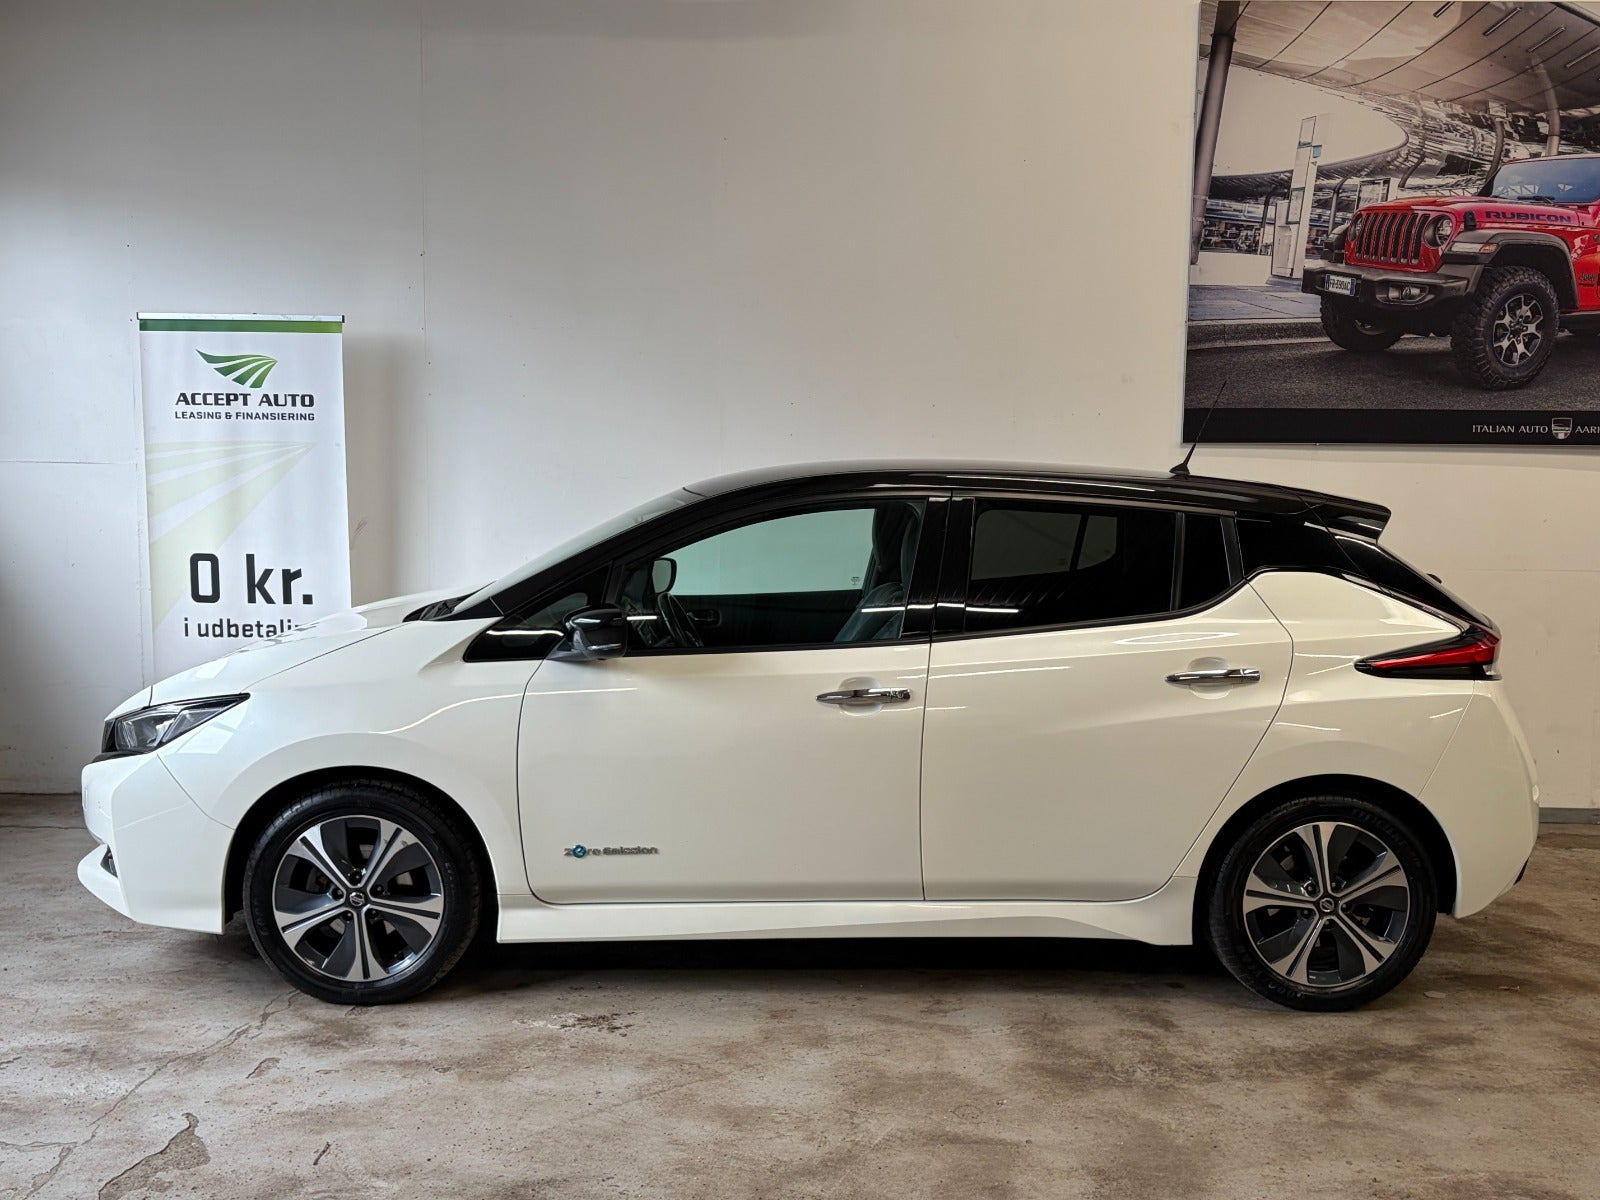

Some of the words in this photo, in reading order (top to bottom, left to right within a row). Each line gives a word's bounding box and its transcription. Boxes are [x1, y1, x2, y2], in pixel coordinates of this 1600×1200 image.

[1485, 211, 1572, 222] RUBICON
[176, 392, 251, 406] ACCEPT
[259, 394, 315, 408] AUTO
[175, 411, 222, 420] LEASING
[225, 411, 233, 420] &
[235, 412, 315, 421] FINANSIERING
[1472, 424, 1515, 433] ITALIAN
[1518, 425, 1548, 433] AUTO
[190, 553, 221, 603] 0
[245, 553, 313, 604] kr.
[184, 617, 189, 637] i
[197, 618, 300, 638] udbetali
[564, 844, 601, 858] Zero
[602, 846, 658, 855] Emission
